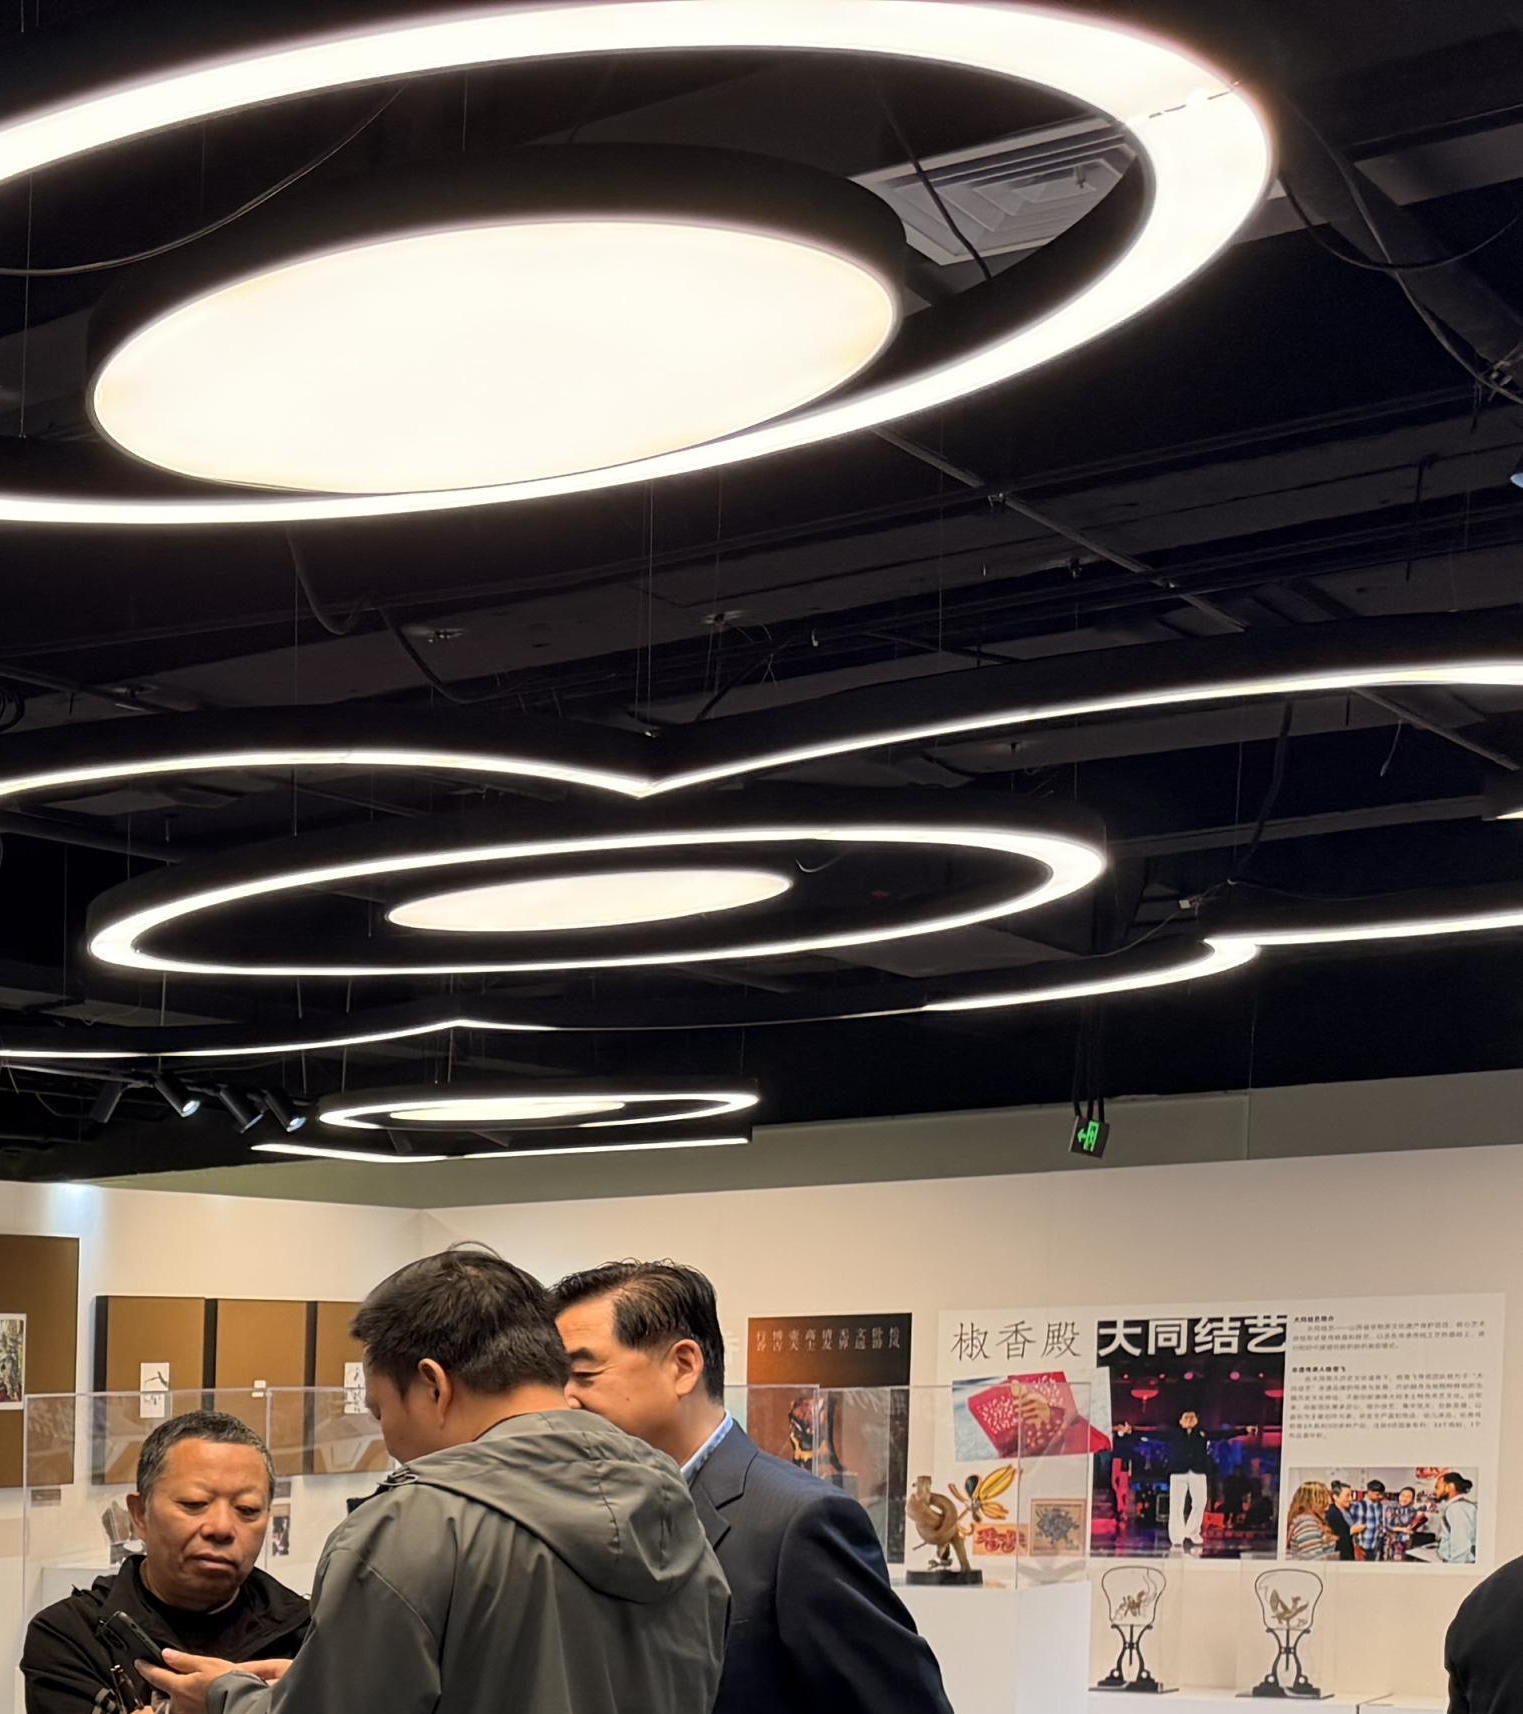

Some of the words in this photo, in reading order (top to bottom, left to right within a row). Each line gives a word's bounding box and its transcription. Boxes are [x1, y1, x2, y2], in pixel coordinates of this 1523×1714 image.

[950, 1320, 1081, 1361] 椒香殿
[1098, 1315, 1287, 1358] 大同结艺
